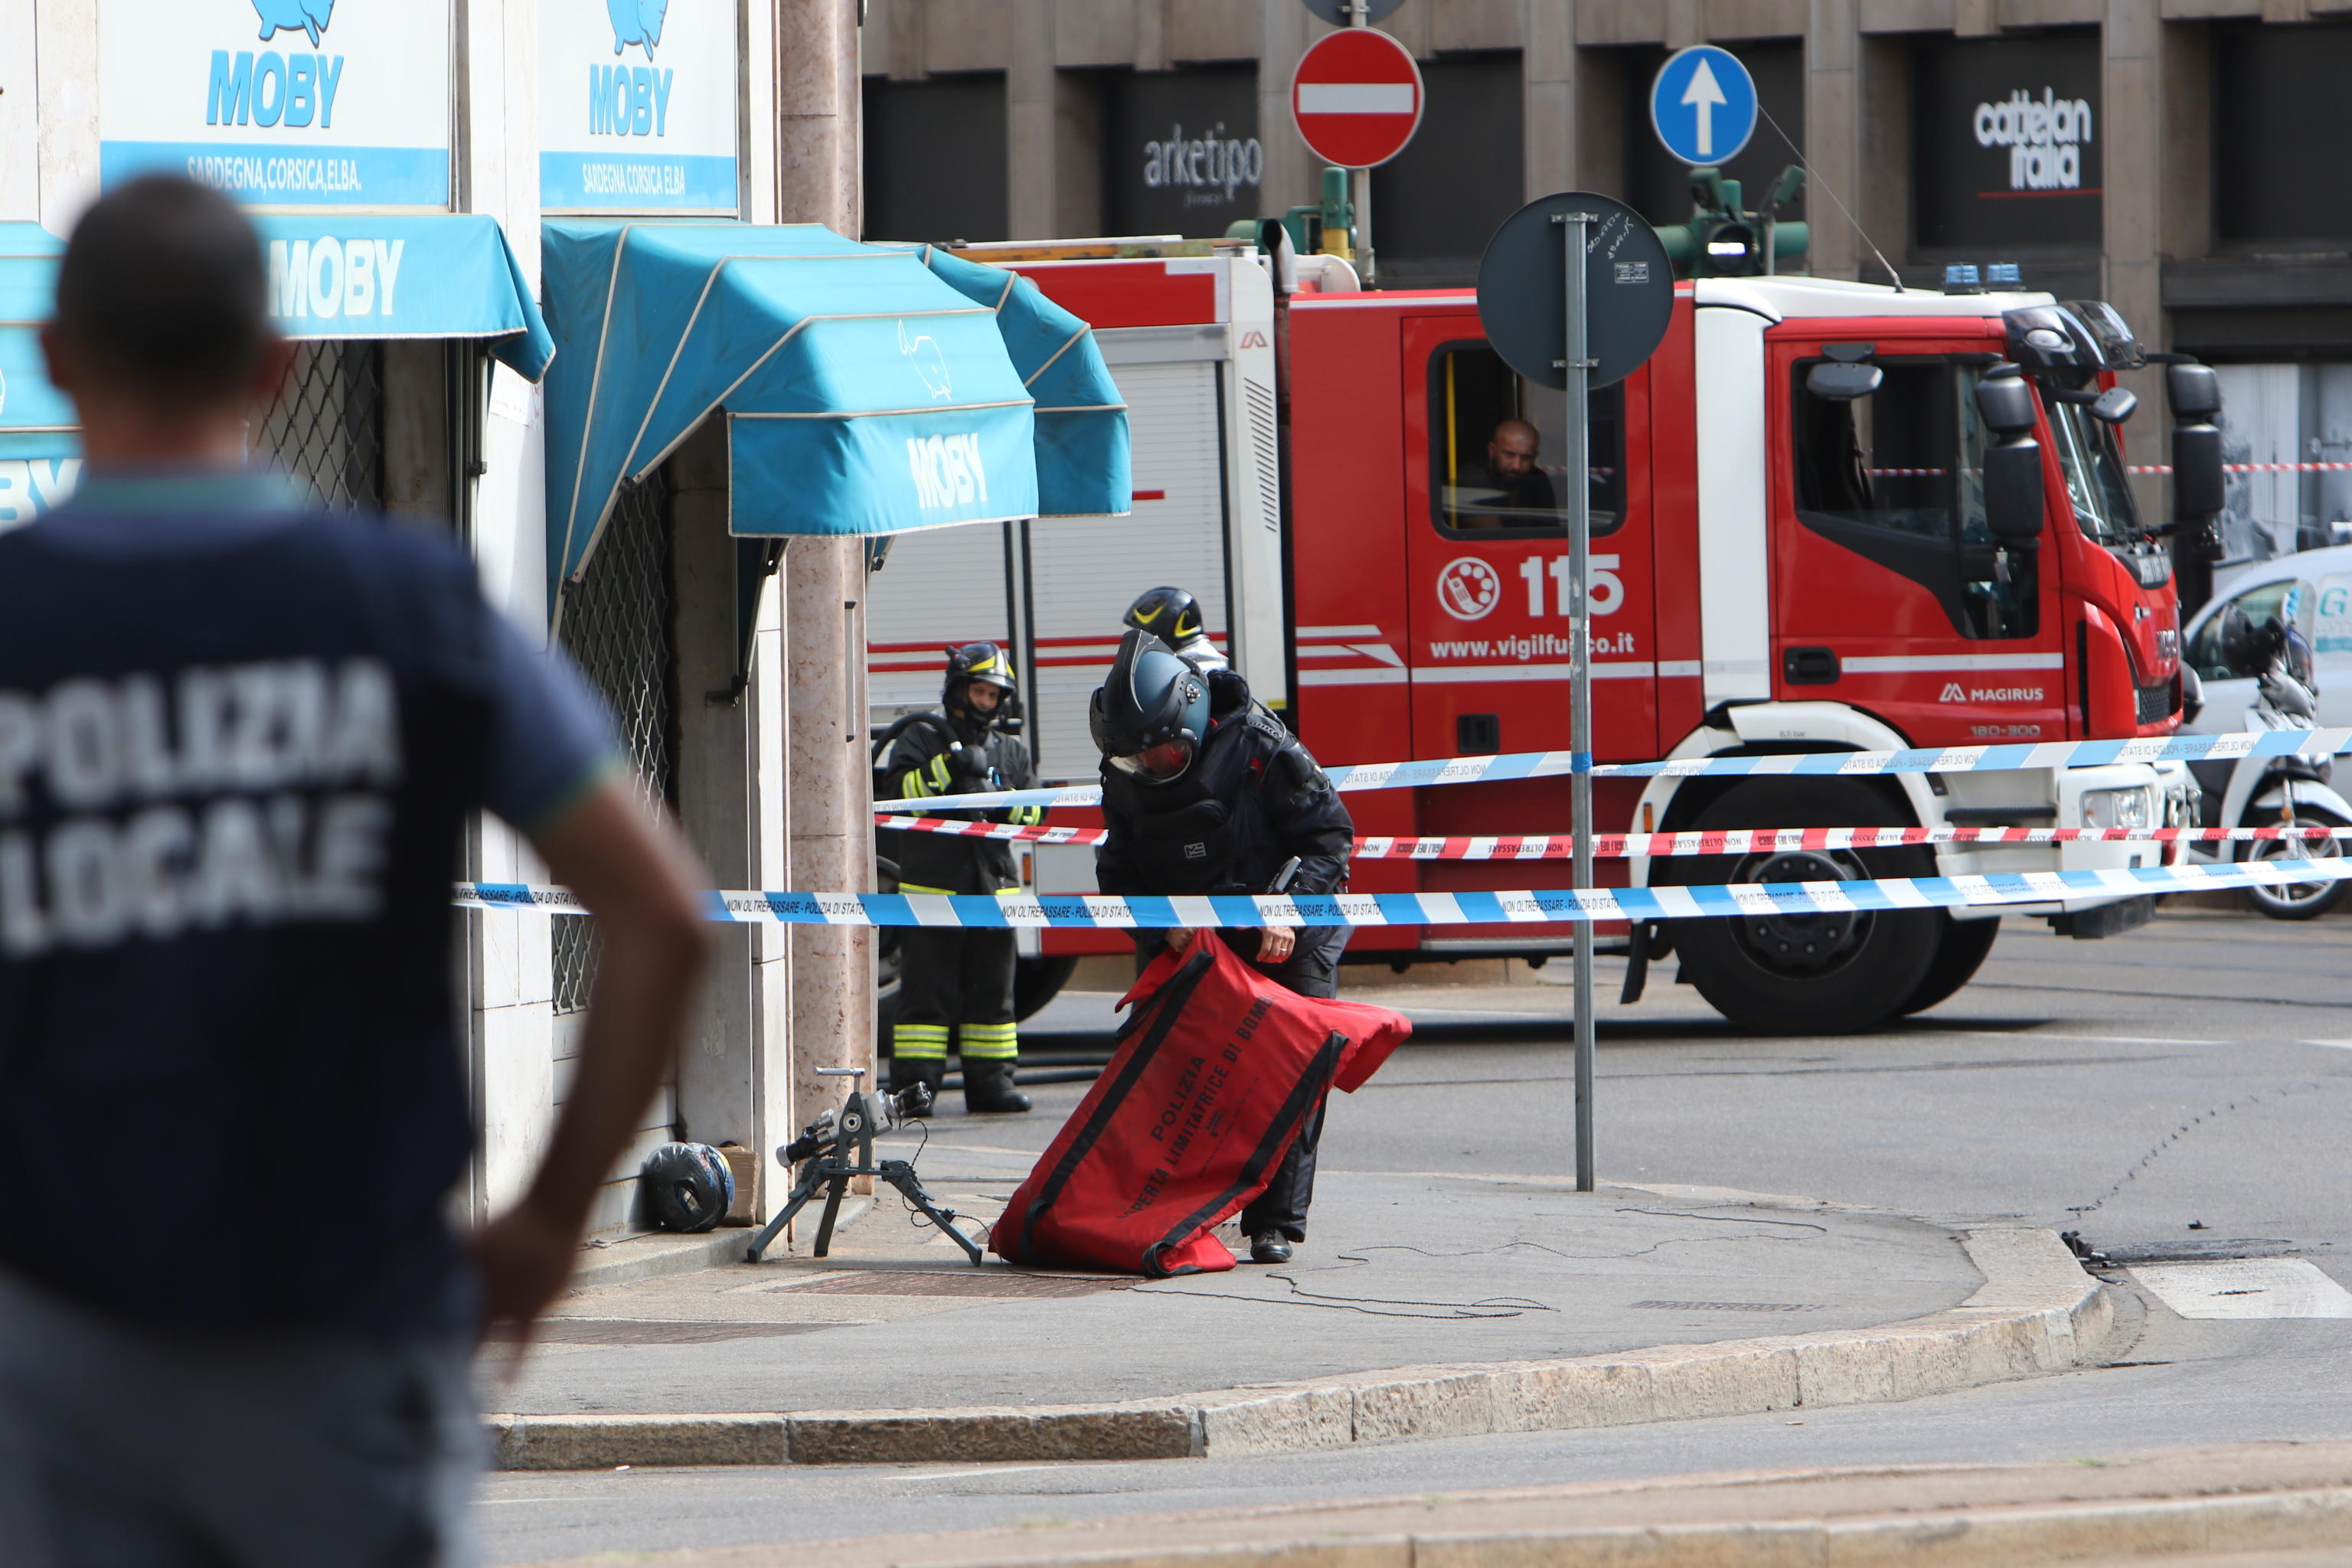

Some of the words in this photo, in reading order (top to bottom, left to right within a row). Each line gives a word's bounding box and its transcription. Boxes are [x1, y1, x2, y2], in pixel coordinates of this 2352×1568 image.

[207, 50, 345, 128] MOBY
[589, 64, 674, 136] MOBY
[1974, 86, 2092, 147] cattelan
[1144, 121, 1263, 202] arketipo
[583, 163, 626, 193] SARDEGNA
[626, 165, 662, 194] CORSICA
[664, 165, 685, 194] ELBA
[269, 236, 406, 318] MOBY
[906, 432, 988, 508] MOBY
[1519, 554, 1624, 617] 115
[1430, 632, 1635, 659] www.vigilfuo.it
[1970, 688, 2043, 701] MAGIRUS
[0, 656, 402, 816] POLIZIA
[1363, 844, 1380, 852] NON
[1488, 843, 1544, 853] OLTREPASSARE
[1546, 843, 1563, 852] NON
[1724, 838, 1742, 847] NON
[0, 792, 394, 957] LOCALE
[449, 887, 508, 901] LTREPASSARE
[514, 890, 543, 903] POLIZIA
[545, 892, 554, 903] DI
[554, 893, 578, 905] STATO
[726, 900, 743, 912] NON
[743, 900, 800, 913] OLTREPASSARE
[805, 901, 831, 914] POLIZIA
[833, 903, 841, 914] DI
[841, 903, 864, 915] STATO
[1259, 904, 1272, 917] NON
[1275, 904, 1323, 917] OLTREPASSARE
[1329, 904, 1351, 916] POLIZIA
[1353, 904, 1360, 916] DI
[1361, 903, 1380, 916] STATO
[1503, 900, 1515, 913] NON
[1517, 900, 1563, 912] OLTREPASSARE
[1568, 899, 1590, 911] POLIZIA
[1592, 899, 1598, 910] DI
[1599, 898, 1619, 910] STATO
[1002, 906, 1017, 918] NON
[1018, 906, 1070, 918] OLTREPASSARE
[1076, 906, 1100, 918] POLIZIA
[1101, 906, 1109, 917] DI
[1110, 906, 1132, 917] STATO
[1165, 1064, 1230, 1166] LIMITATRICE
[1223, 1043, 1242, 1064] DI
[1236, 995, 1276, 1041] BOMB
[1151, 1056, 1206, 1142] POLIZIA
